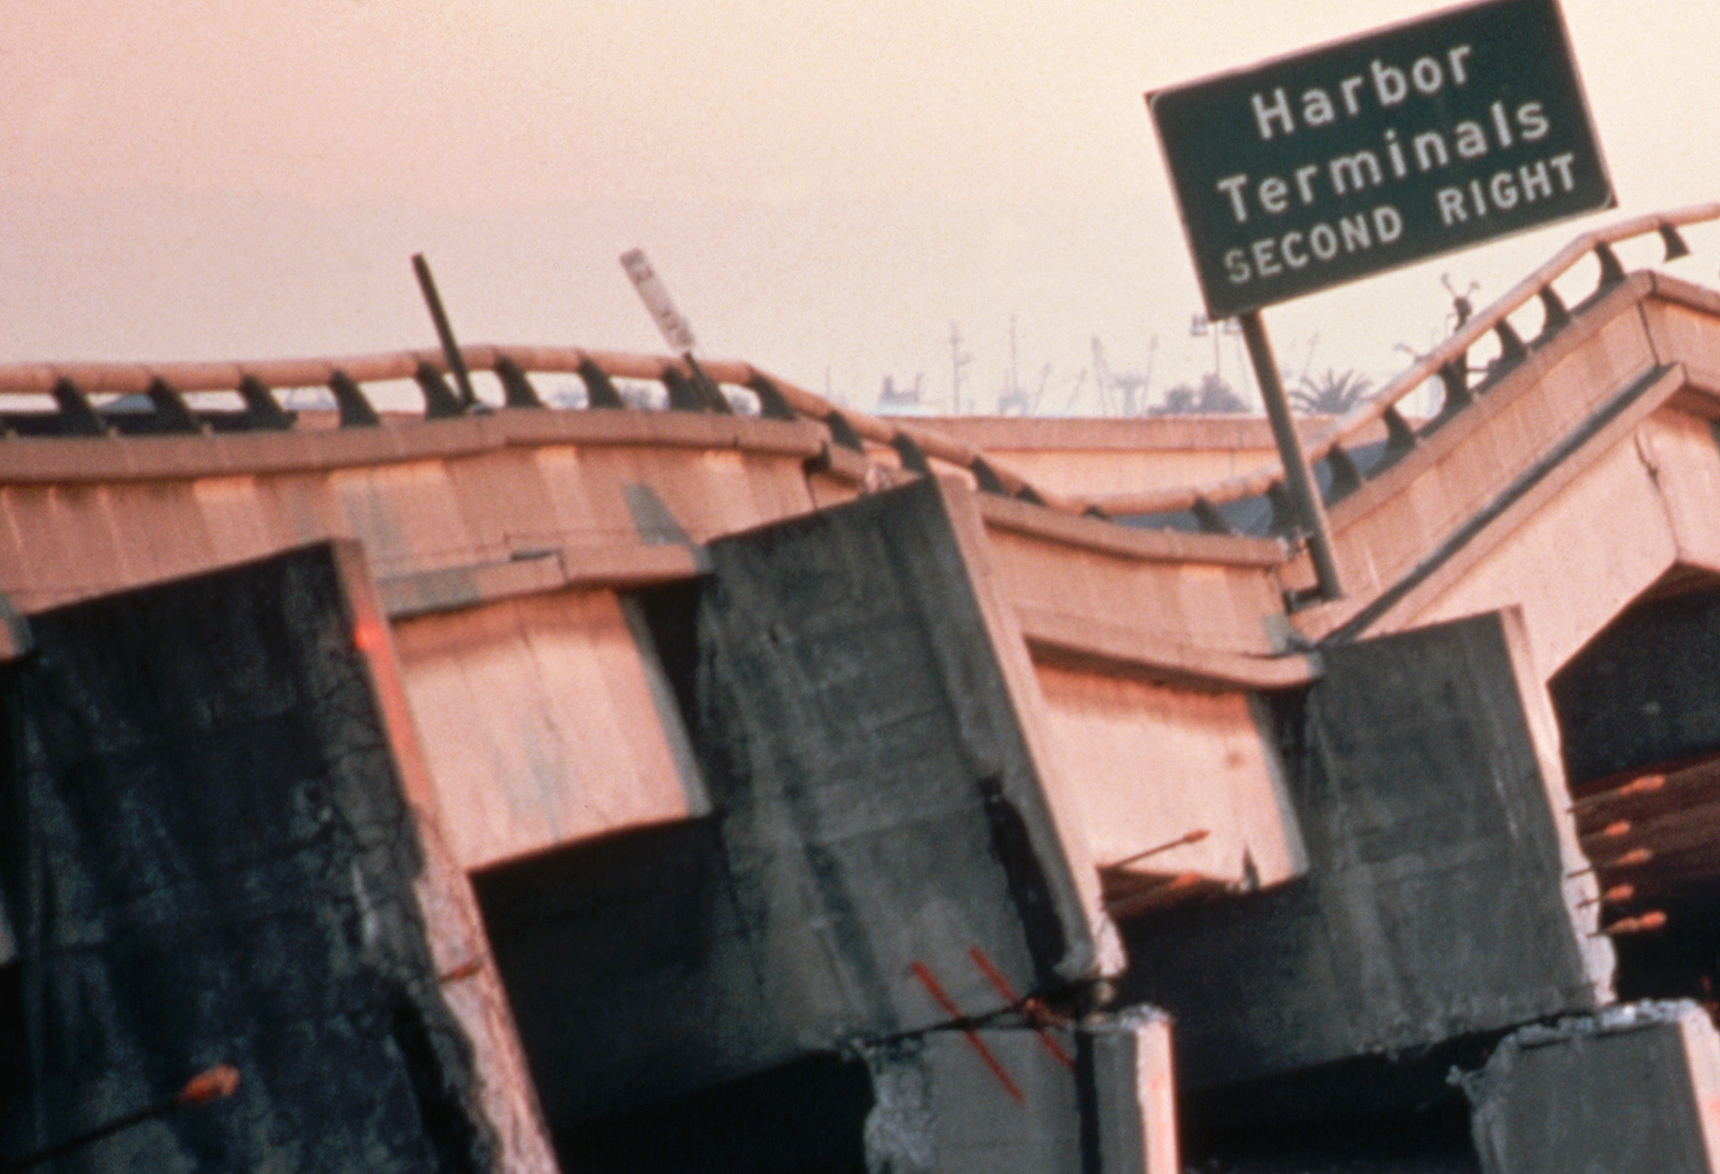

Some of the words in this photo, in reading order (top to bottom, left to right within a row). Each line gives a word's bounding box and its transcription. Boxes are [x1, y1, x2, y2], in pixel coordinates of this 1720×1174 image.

[1251, 45, 1472, 139] Harbor
[1217, 100, 1549, 223] Terminals
[1223, 206, 1402, 285] SECOND
[1436, 152, 1576, 227] RIGHT
